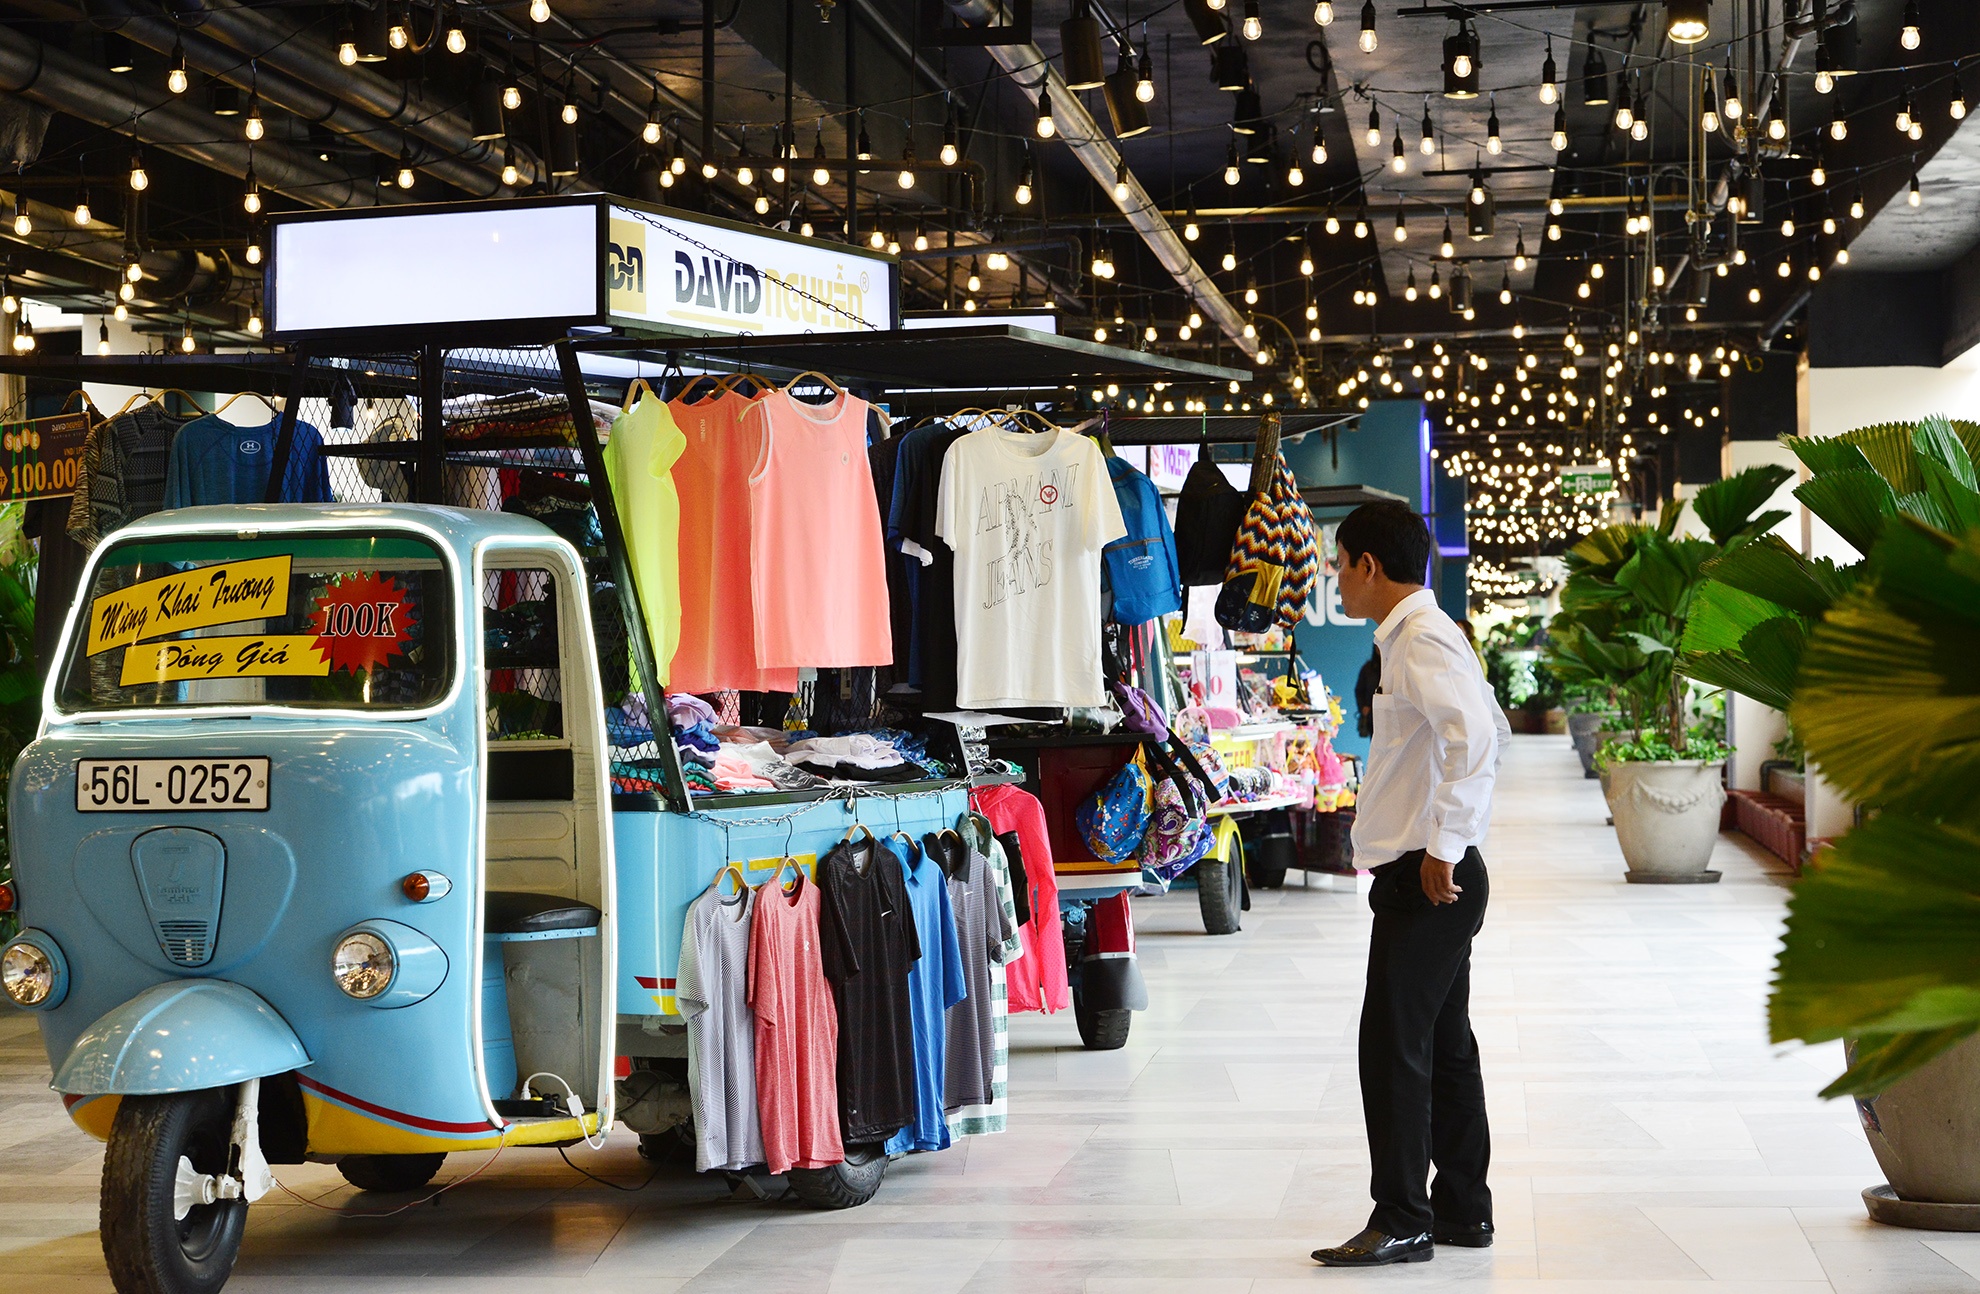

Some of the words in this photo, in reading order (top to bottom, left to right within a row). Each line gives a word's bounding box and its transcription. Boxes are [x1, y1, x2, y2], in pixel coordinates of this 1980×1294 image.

[675, 250, 761, 315] DAVID
[6, 431, 38, 450] SALE
[975, 463, 1079, 535] ARMANI
[156, 583, 202, 620] Khai
[209, 569, 275, 610] Trương
[982, 540, 1054, 610] JEANS
[319, 602, 398, 637] 100K
[236, 641, 289, 673] Giá
